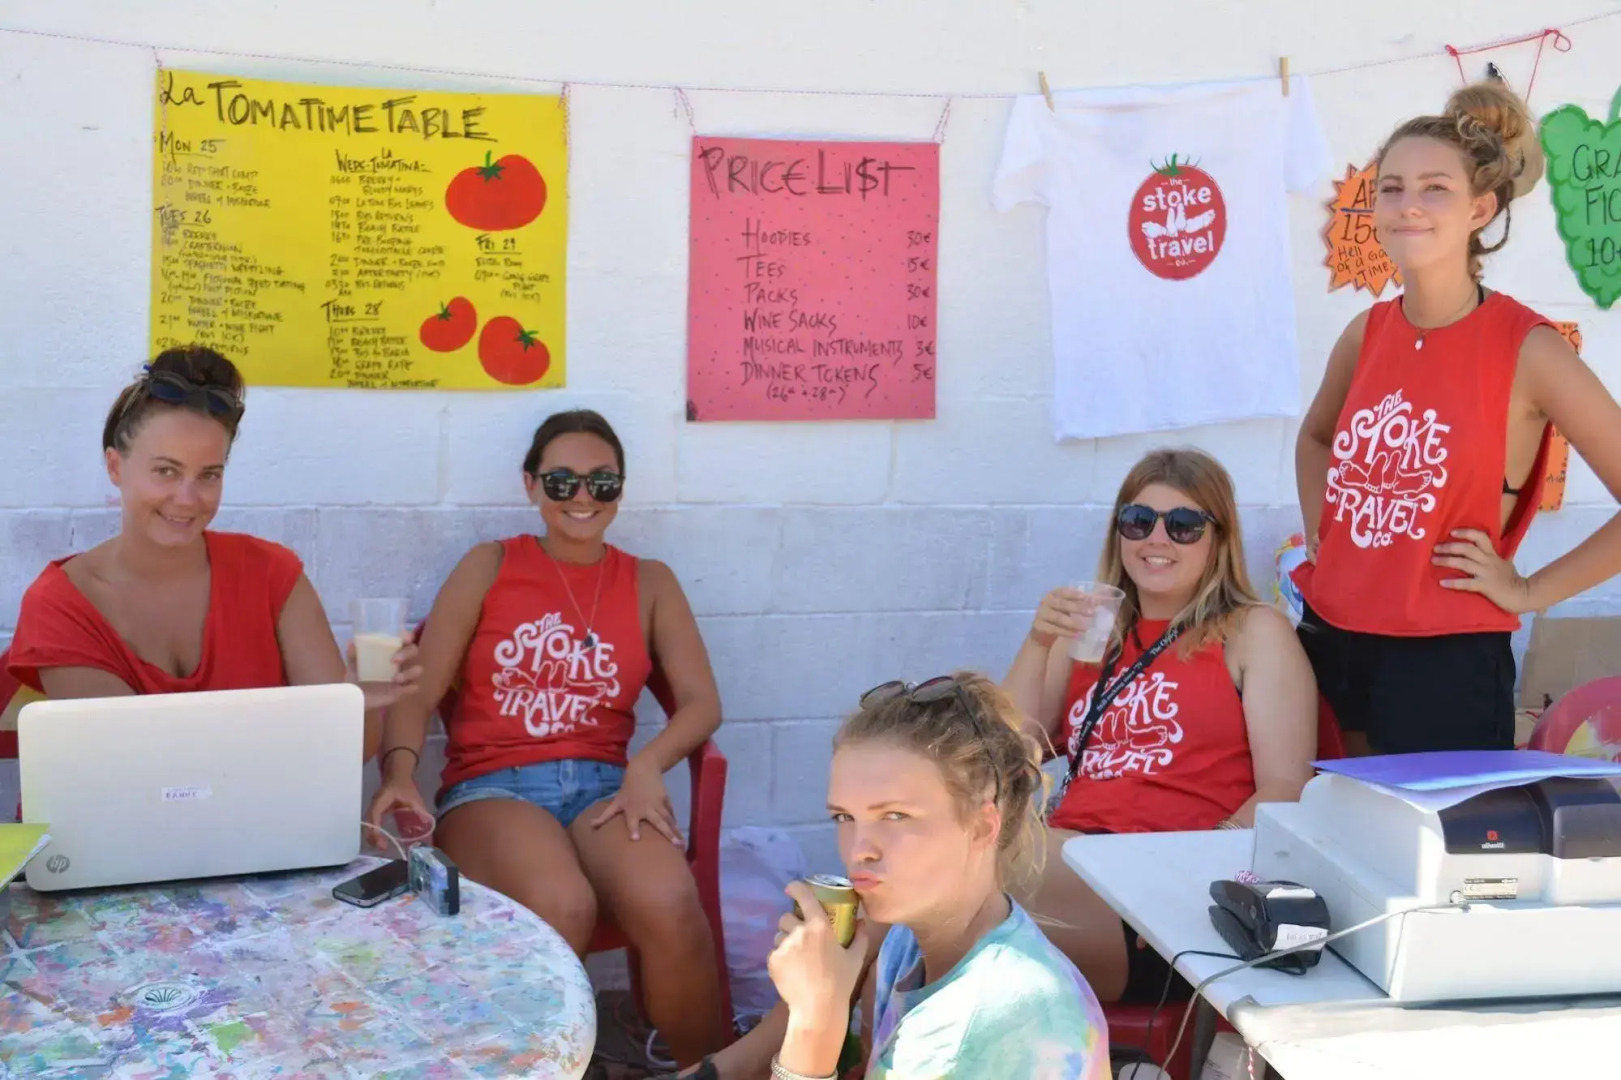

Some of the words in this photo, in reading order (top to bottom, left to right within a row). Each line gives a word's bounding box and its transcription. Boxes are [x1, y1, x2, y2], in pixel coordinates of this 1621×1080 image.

[200, 138, 226, 154] 25
[1169, 178, 1183, 186] the
[1142, 184, 1212, 212] stoke
[194, 209, 212, 225] 26
[741, 218, 812, 257] HOODIES
[1147, 230, 1214, 260] travel
[737, 253, 786, 278] TEES
[744, 282, 799, 303] PACKS
[744, 308, 782, 332] WINE
[789, 310, 837, 337] SACKS
[743, 336, 805, 366] MUSICAL
[813, 338, 904, 367] INSTRUMENTS
[740, 360, 807, 387] DINNER
[1333, 401, 1450, 488] STOKE
[493, 623, 620, 697] STOKE
[48, 855, 69, 873] hp
